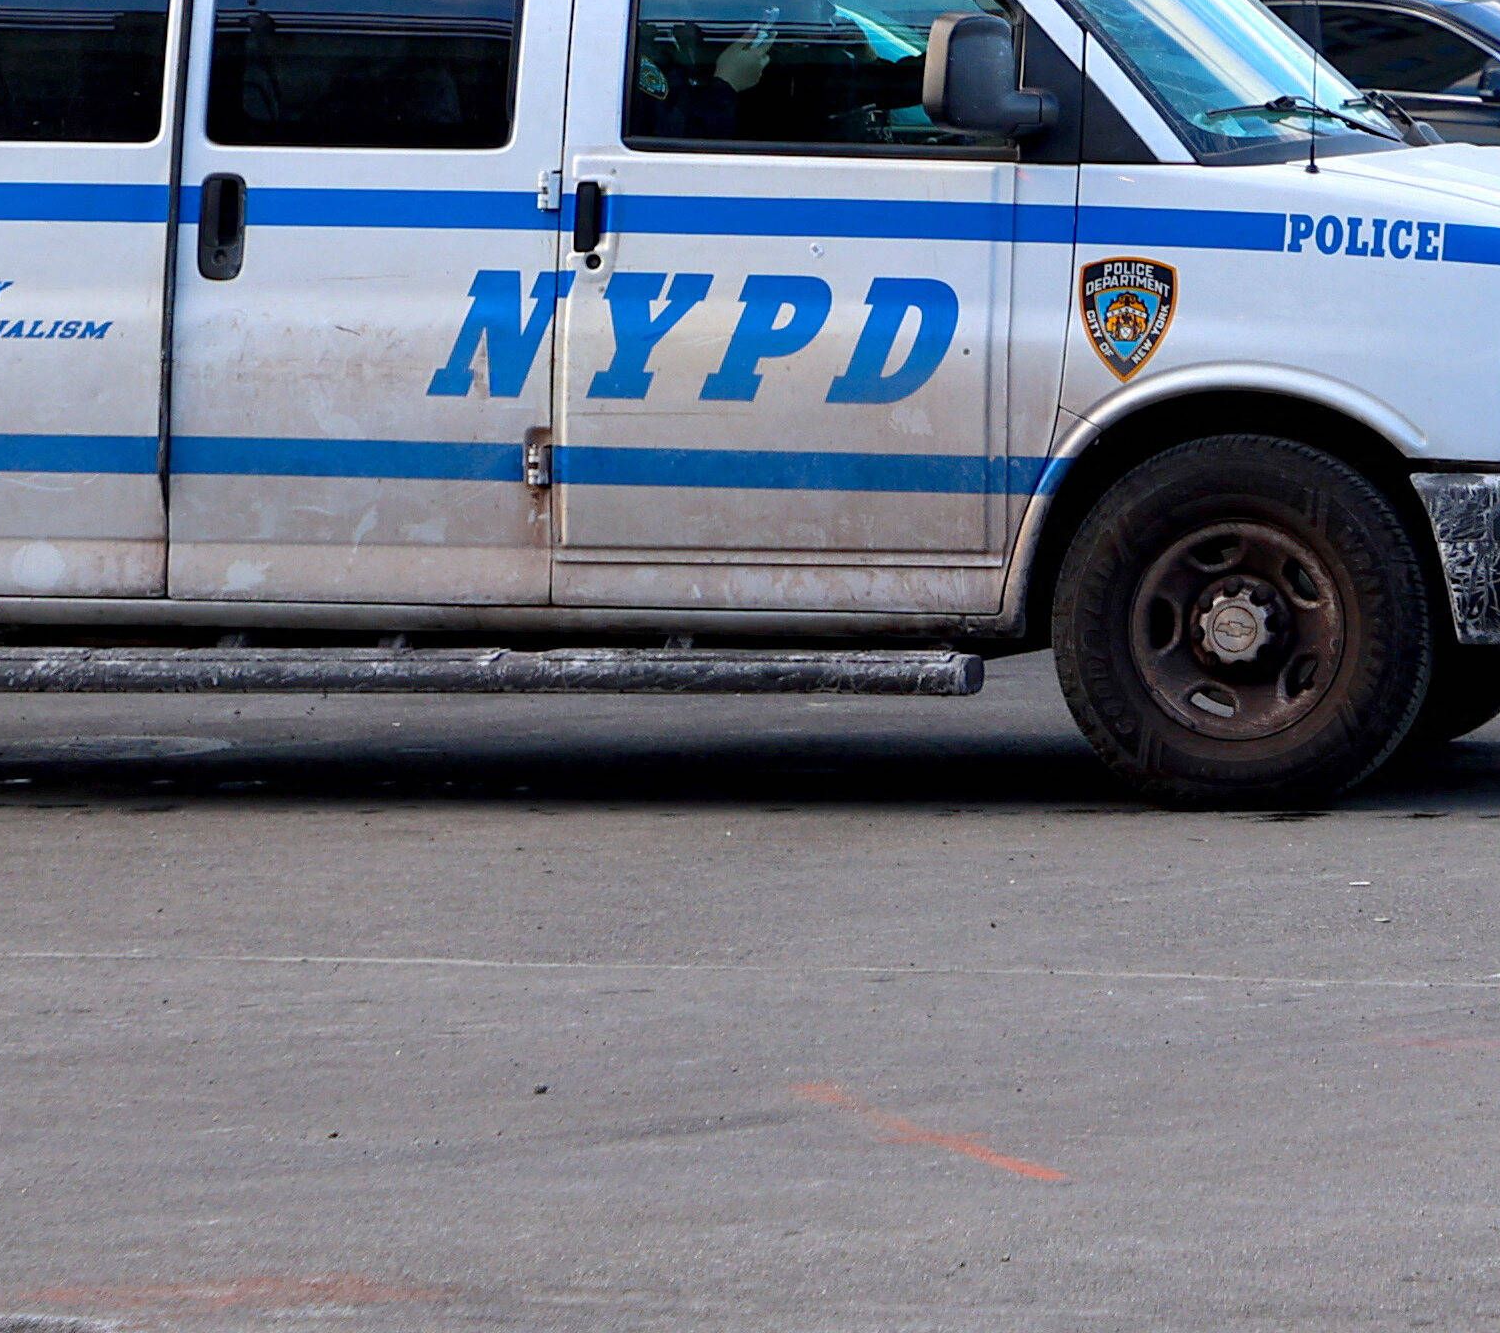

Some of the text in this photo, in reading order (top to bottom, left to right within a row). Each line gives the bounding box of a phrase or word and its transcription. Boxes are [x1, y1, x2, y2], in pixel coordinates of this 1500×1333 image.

[1287, 213, 1440, 261] POLICE
[1085, 275, 1170, 297] DEPARTMENT
[1104, 262, 1154, 278] POLICE
[426, 269, 960, 404] NYPD
[1086, 304, 1170, 364] CITY OF NEW YORK
